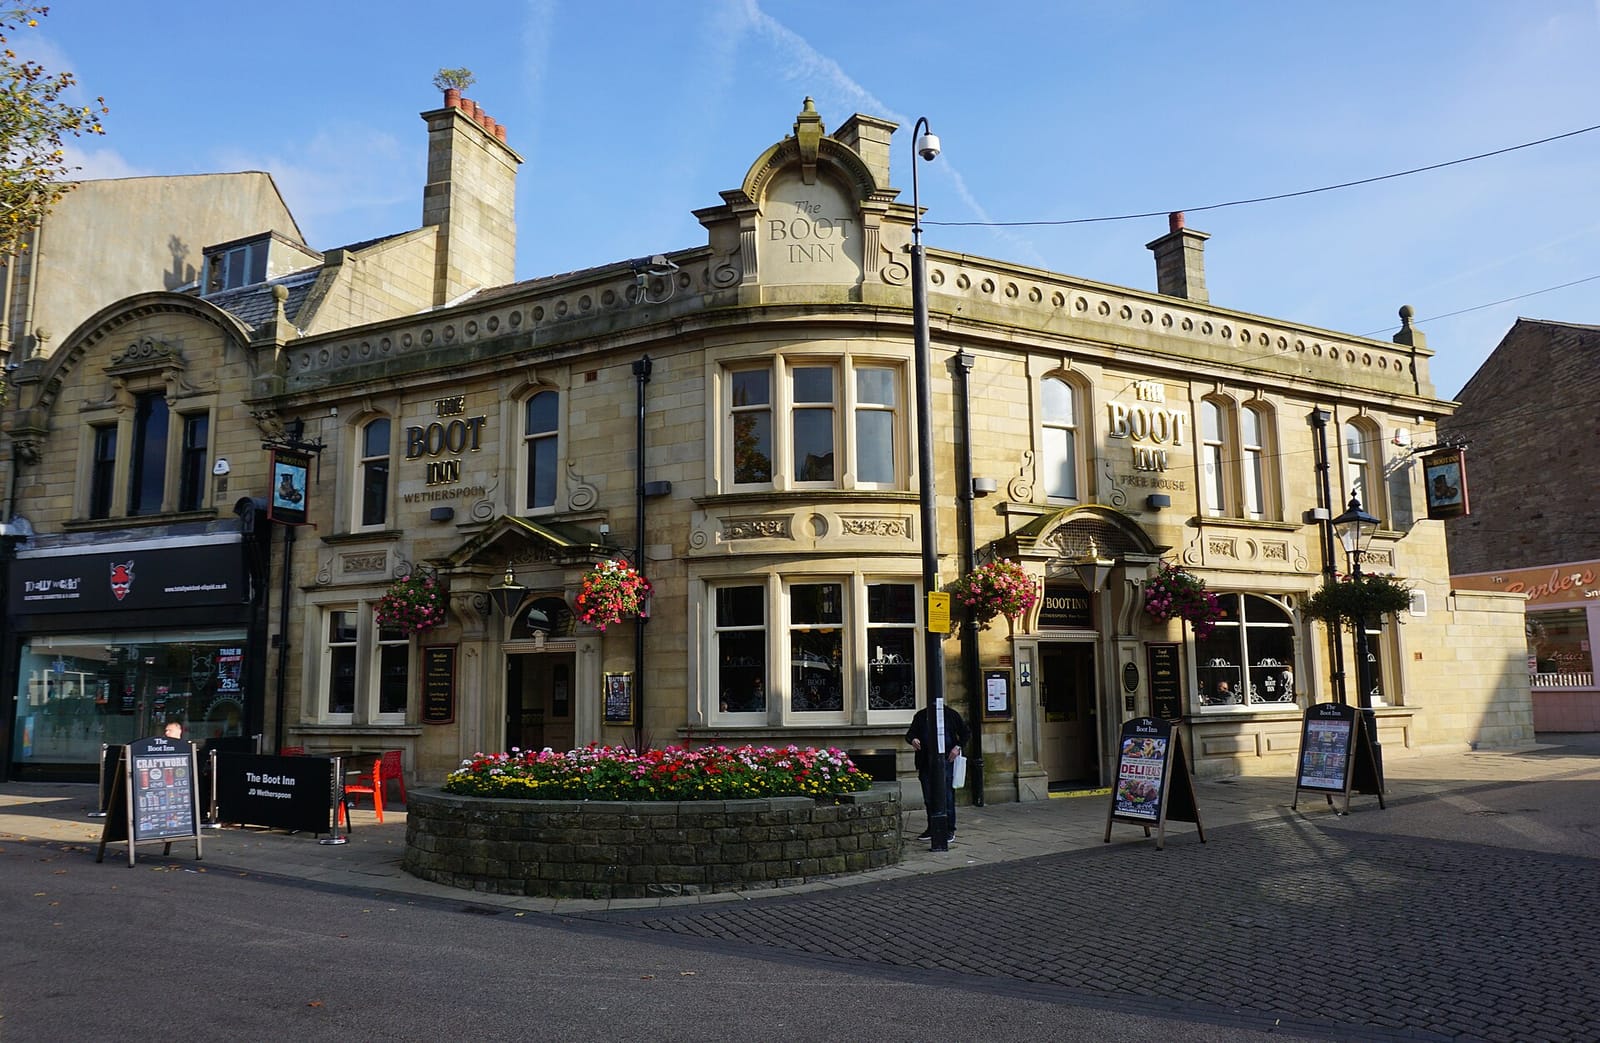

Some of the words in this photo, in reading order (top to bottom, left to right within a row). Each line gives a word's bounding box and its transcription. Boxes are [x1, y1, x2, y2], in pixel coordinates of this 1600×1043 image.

[795, 201, 821, 214] The
[768, 218, 853, 241] BOOT
[787, 244, 835, 263] INN
[1133, 380, 1165, 403] THE
[435, 395, 464, 417] THE
[1106, 400, 1187, 447] BOOT
[405, 414, 487, 461] BOOT
[1132, 444, 1168, 472] INN
[426, 458, 462, 487] INN
[1151, 477, 1185, 492] HOUSE
[404, 486, 486, 504] WETHERSPOON
[1046, 597, 1071, 609] BOOT
[1072, 598, 1088, 609] INN
[136, 757, 188, 769] CRAFTWORK
[1121, 763, 1144, 776] DELI
[1145, 765, 1161, 777] DEALS
[246, 772, 261, 783] The
[262, 774, 281, 785] Boot
[282, 775, 296, 786] Inn
[248, 788, 256, 796] JD
[257, 788, 292, 800] Wetherspoon
